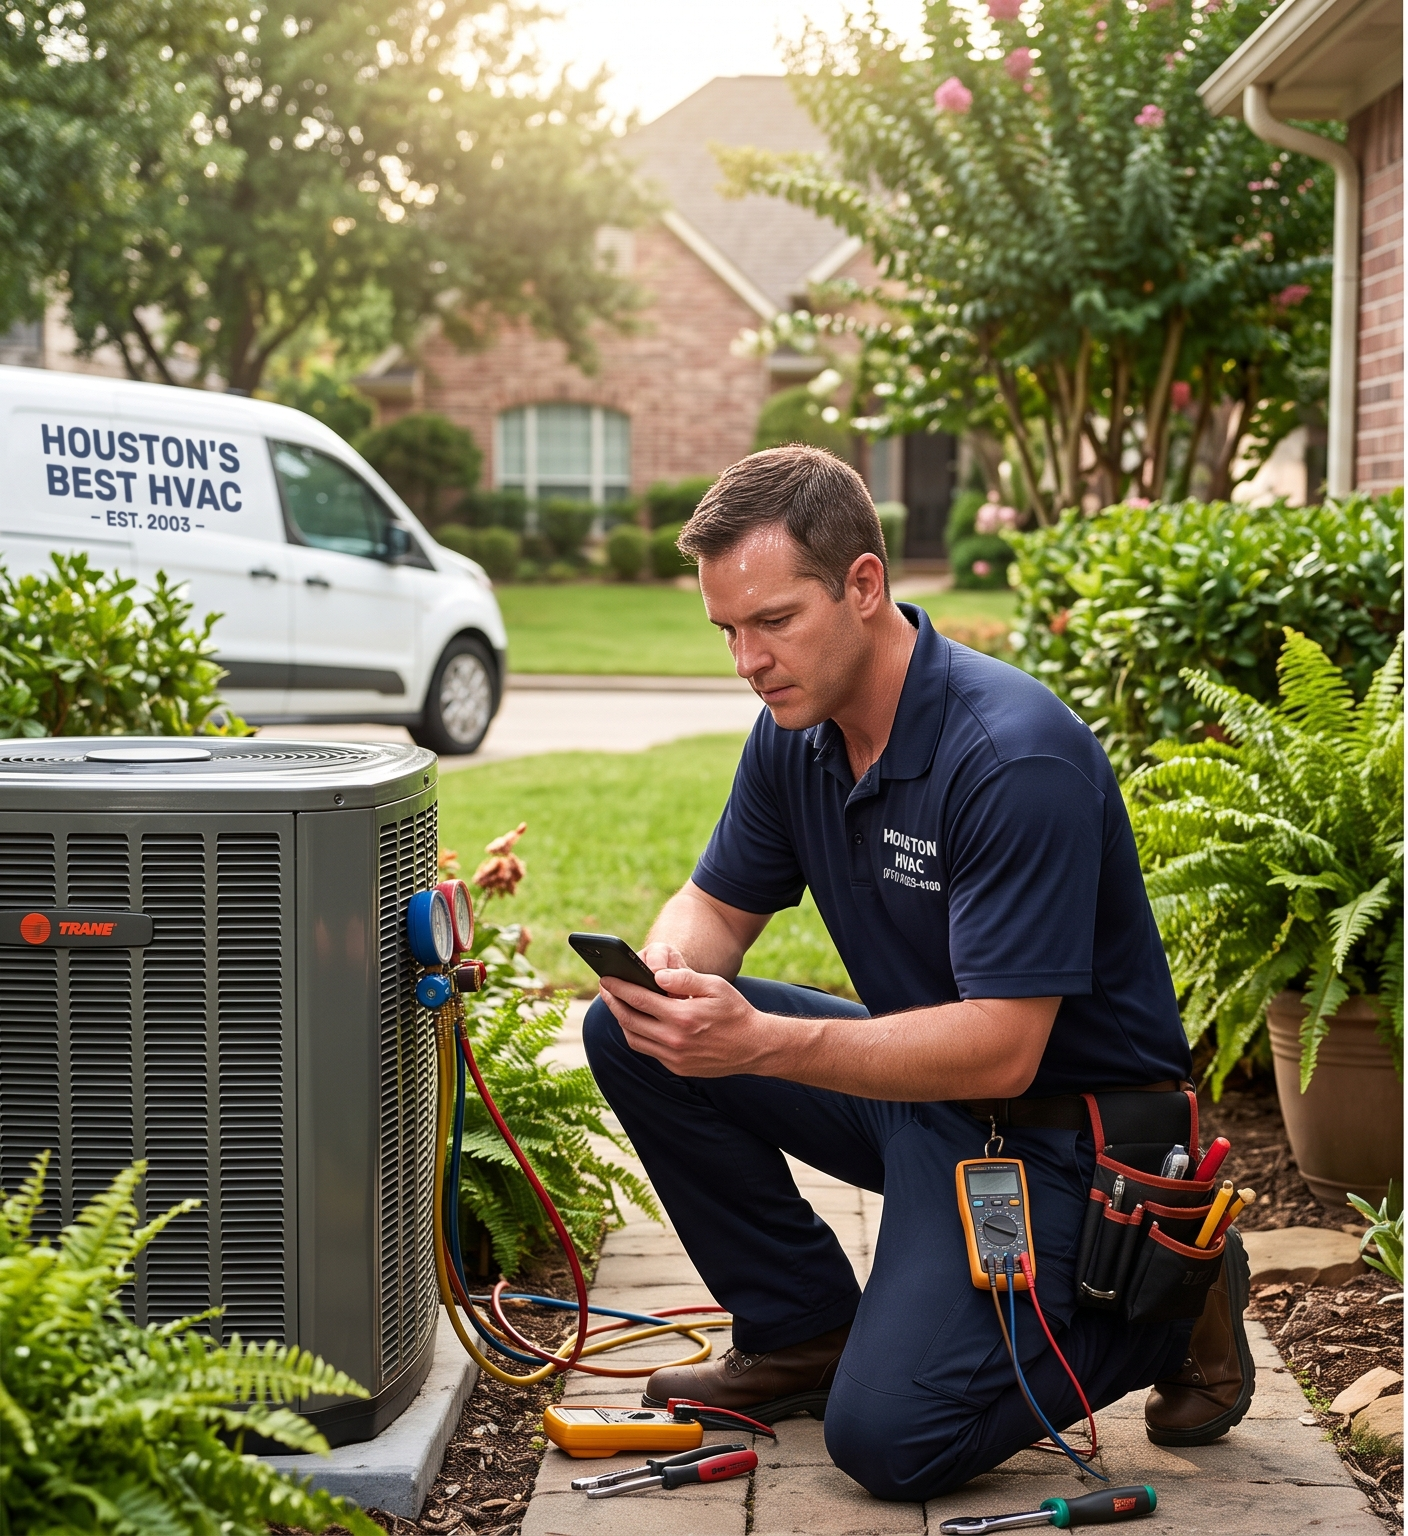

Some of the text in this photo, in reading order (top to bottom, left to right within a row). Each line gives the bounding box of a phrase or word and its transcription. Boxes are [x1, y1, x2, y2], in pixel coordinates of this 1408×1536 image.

[41, 423, 240, 474] HOUSTON'S
[46, 463, 242, 513] BEST HVAC
[106, 510, 143, 529] EST.
[147, 513, 191, 533] 2003
[895, 851, 925, 874] HVAC
[58, 921, 114, 936] TRANE
